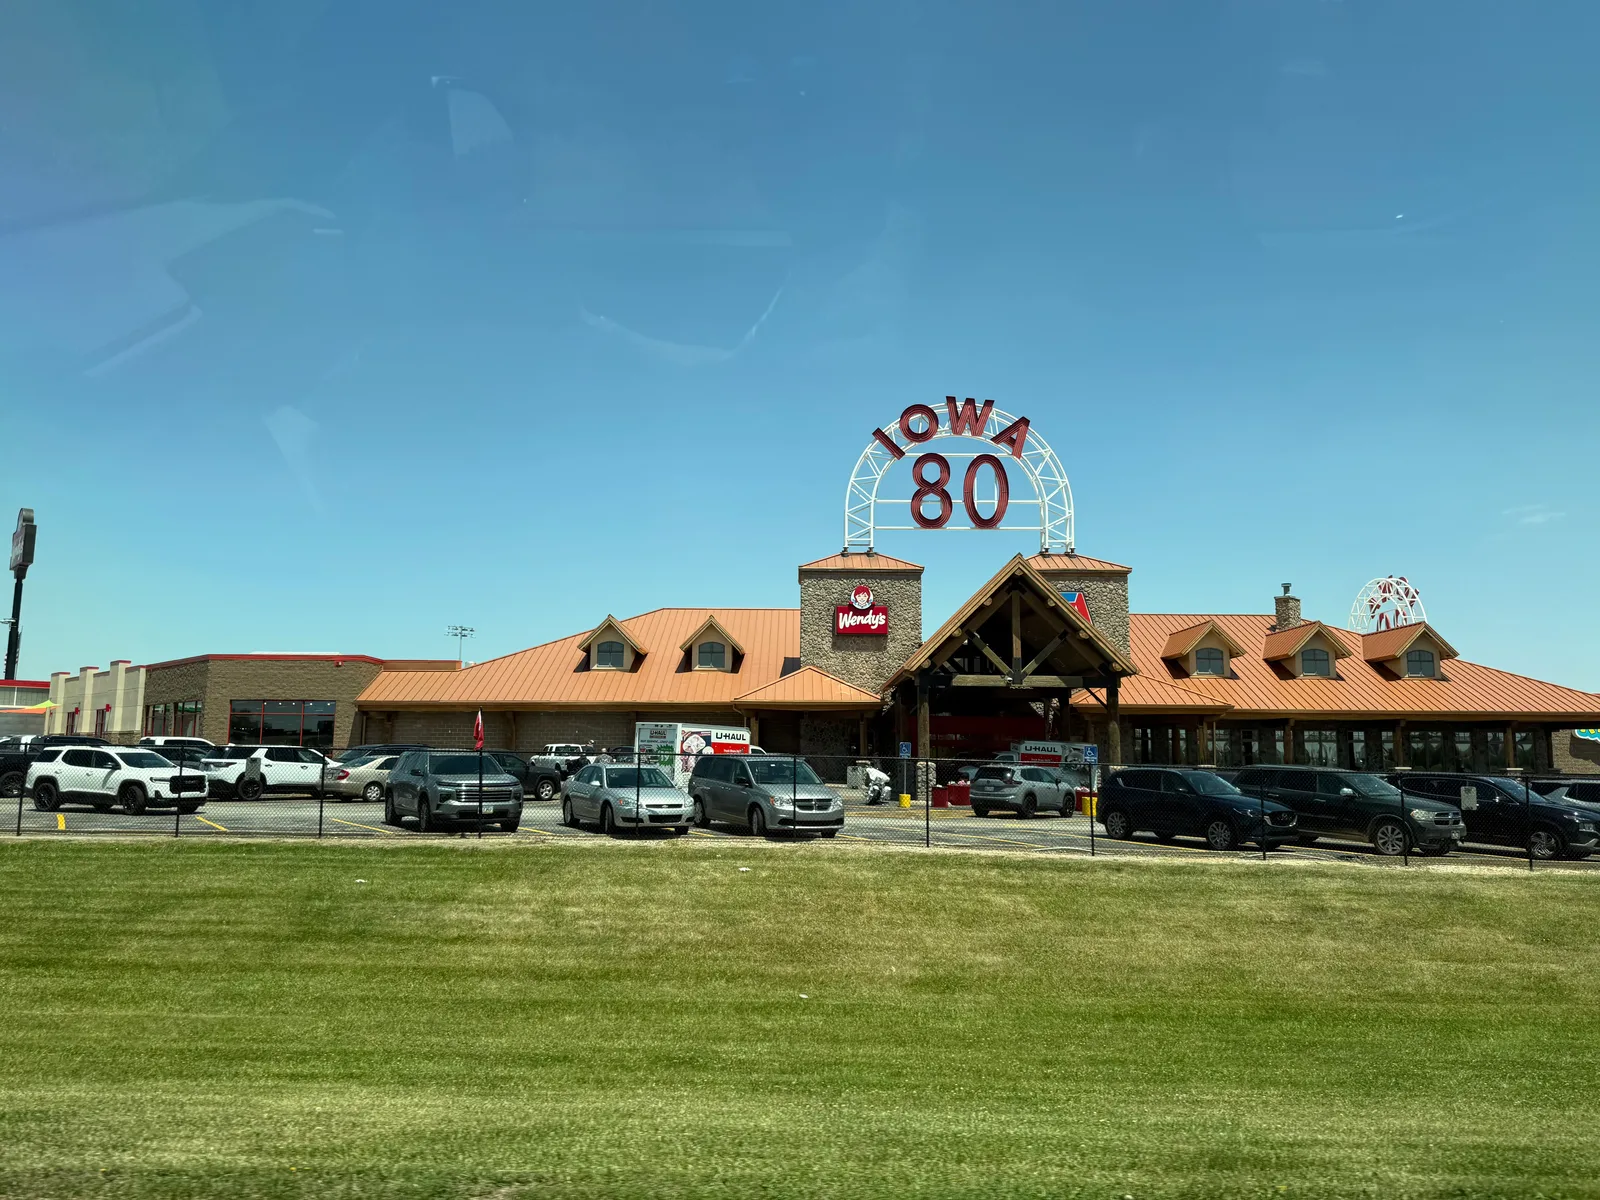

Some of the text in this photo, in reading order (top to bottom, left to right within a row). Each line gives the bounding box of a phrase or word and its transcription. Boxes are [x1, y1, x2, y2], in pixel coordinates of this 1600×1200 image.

[872, 396, 1030, 460] IOWA
[911, 453, 1009, 529] 80
[839, 610, 886, 629] Wendy's
[715, 732, 746, 741] U-HAUL
[1024, 745, 1058, 753] U-HAUL
